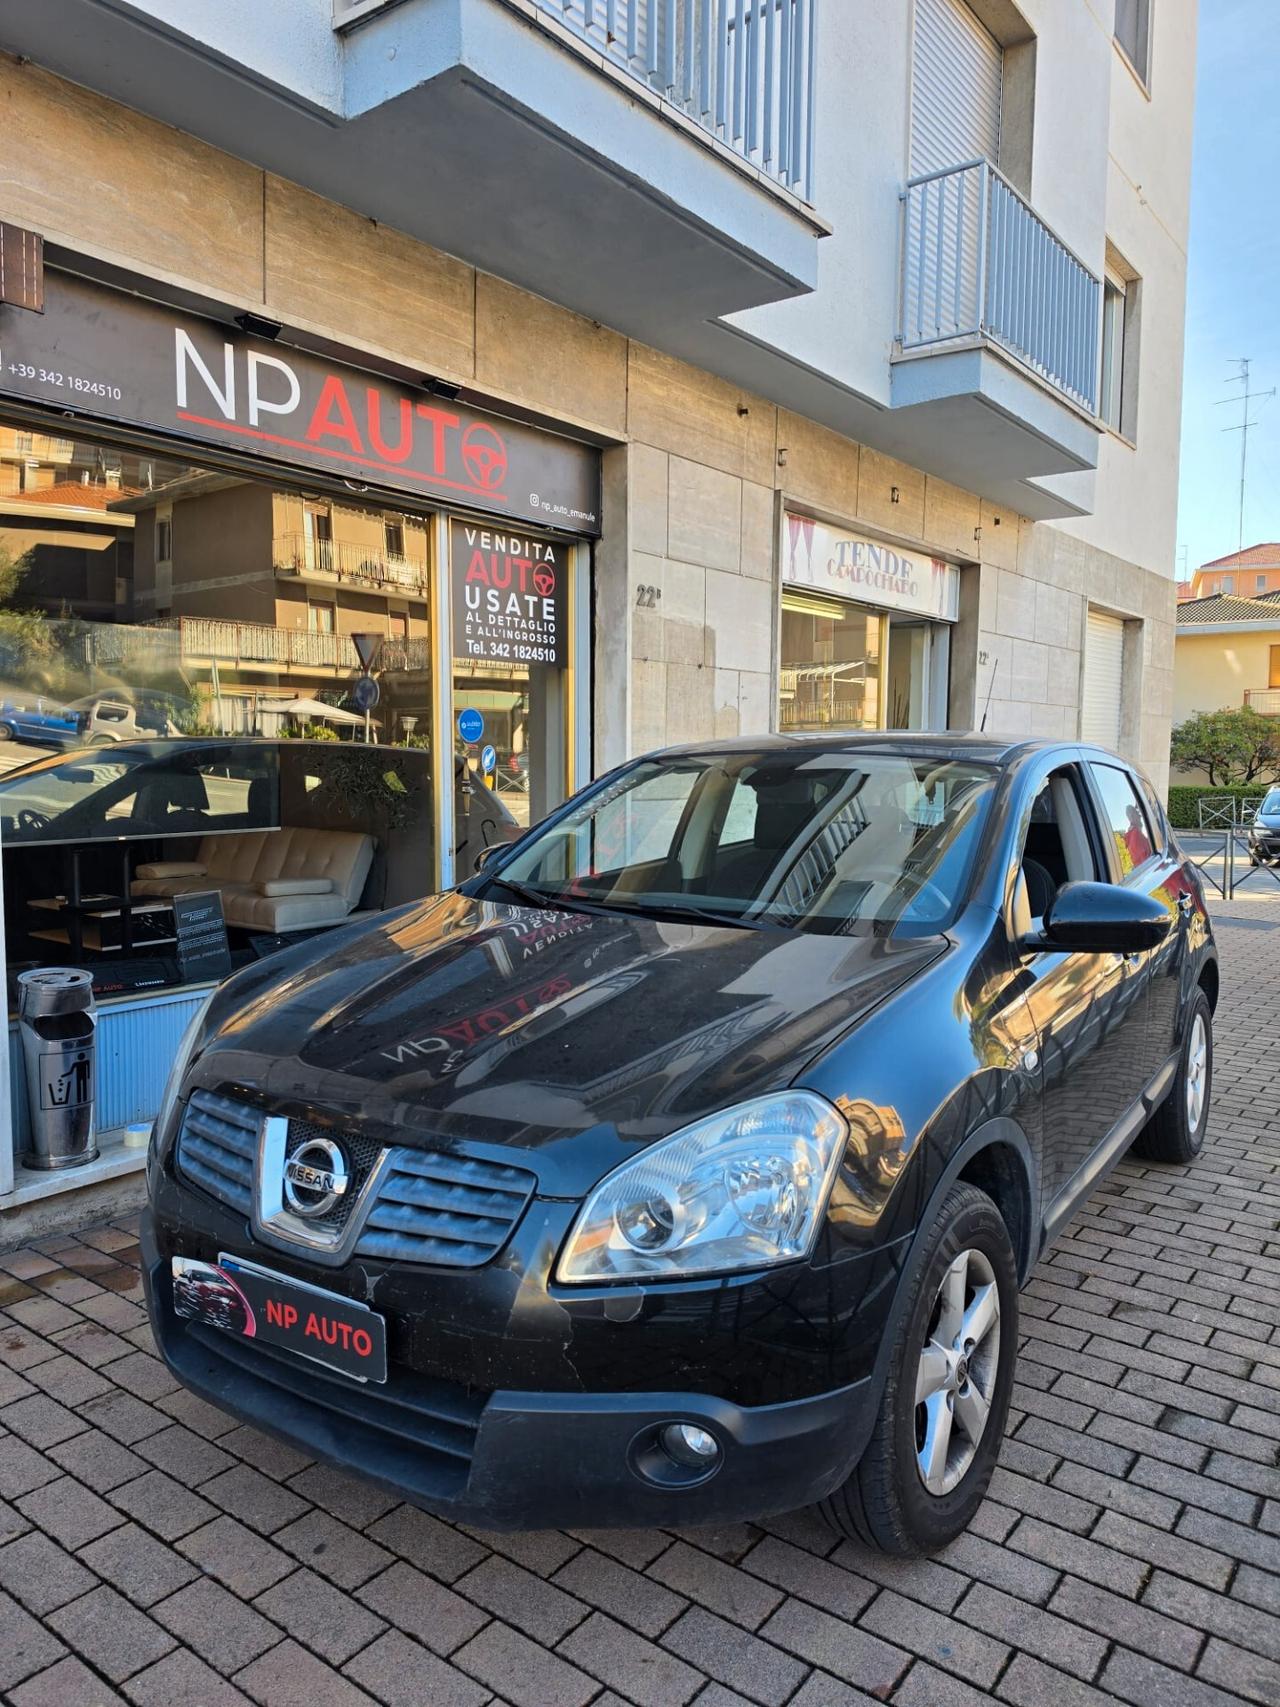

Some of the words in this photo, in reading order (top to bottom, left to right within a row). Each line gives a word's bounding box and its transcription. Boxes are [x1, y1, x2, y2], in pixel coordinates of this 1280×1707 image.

[8, 363, 36, 379] +39
[39, 368, 64, 387] 342
[67, 376, 122, 400] 1824510
[465, 528, 556, 564] VENDITA
[835, 541, 913, 579] TENDE
[465, 549, 556, 597] AUTO
[465, 585, 556, 621] USATE
[465, 624, 473, 635] E
[477, 626, 556, 645] ALL'INGROSSO
[466, 611, 482, 624] AL
[488, 615, 556, 633] DETTAGLIO
[466, 639, 487, 655] Tel.
[490, 642, 510, 658] 342
[513, 644, 556, 662] 1824510
[287, 1162, 335, 1191] NISSAN
[266, 1299, 298, 1329] NP
[304, 1312, 373, 1357] AUTO
